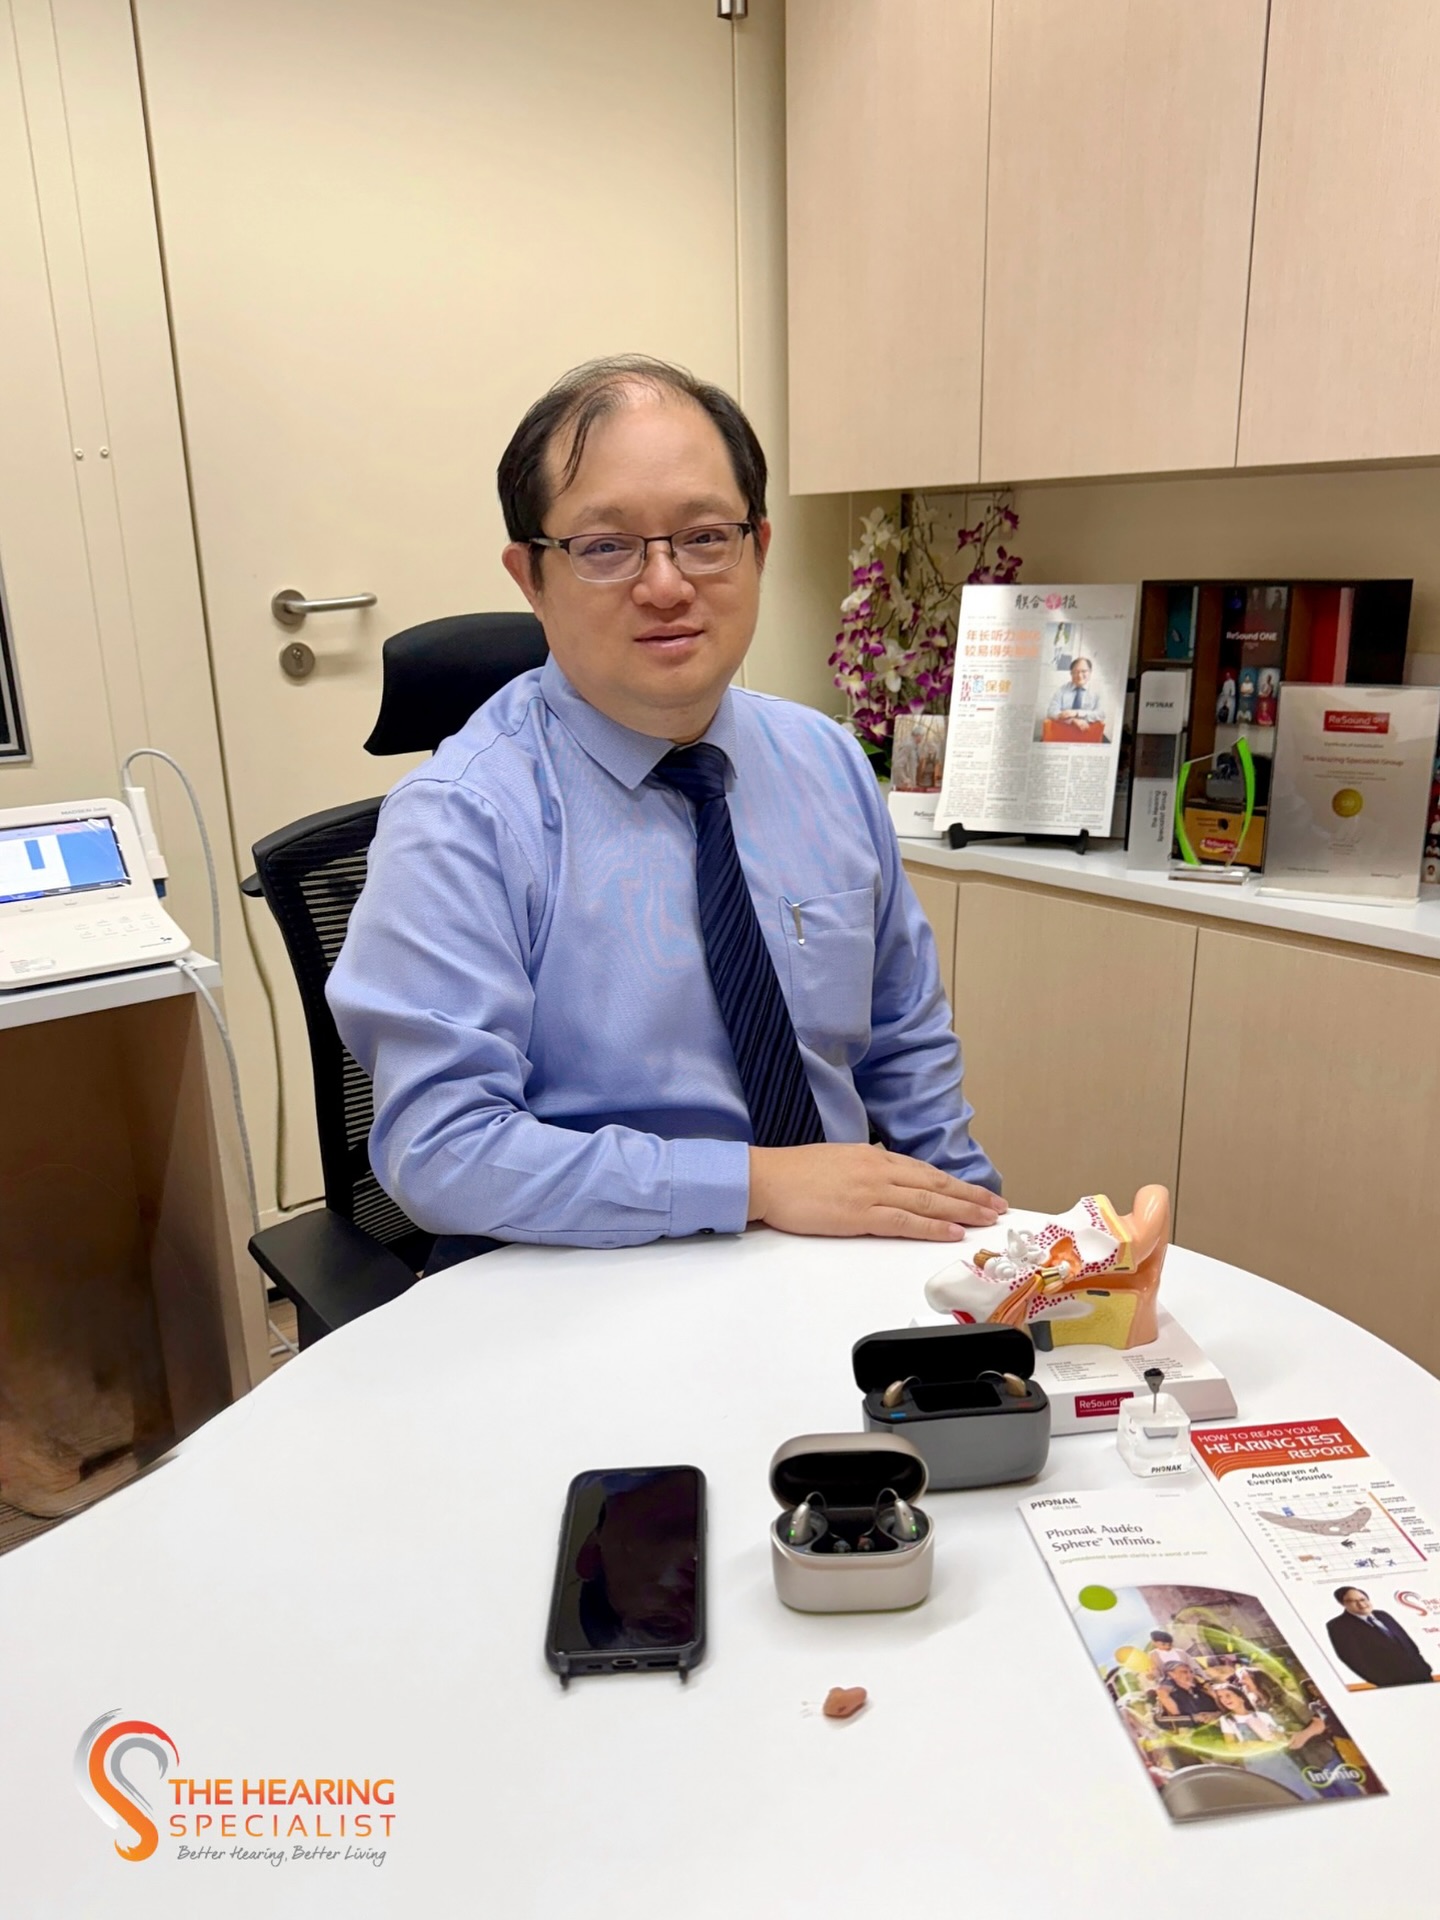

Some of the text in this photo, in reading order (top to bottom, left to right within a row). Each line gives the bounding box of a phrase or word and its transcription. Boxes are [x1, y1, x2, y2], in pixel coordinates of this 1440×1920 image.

[1226, 631, 1277, 641] ReSound ONE
[1328, 715, 1371, 725] ReSound
[1080, 1398, 1118, 1409] ReSound
[1197, 1425, 1320, 1443] HOW TO READ YOUR
[1203, 1432, 1345, 1455] HEARING TEST
[1287, 1444, 1355, 1460] REPORT
[1151, 1464, 1182, 1474] PHONAK
[1251, 1466, 1319, 1480] Audiogram of
[1246, 1473, 1333, 1487] Everyday Sounds
[1030, 1497, 1079, 1510] PHONAK
[1045, 1523, 1143, 1540] Phonak Audéo
